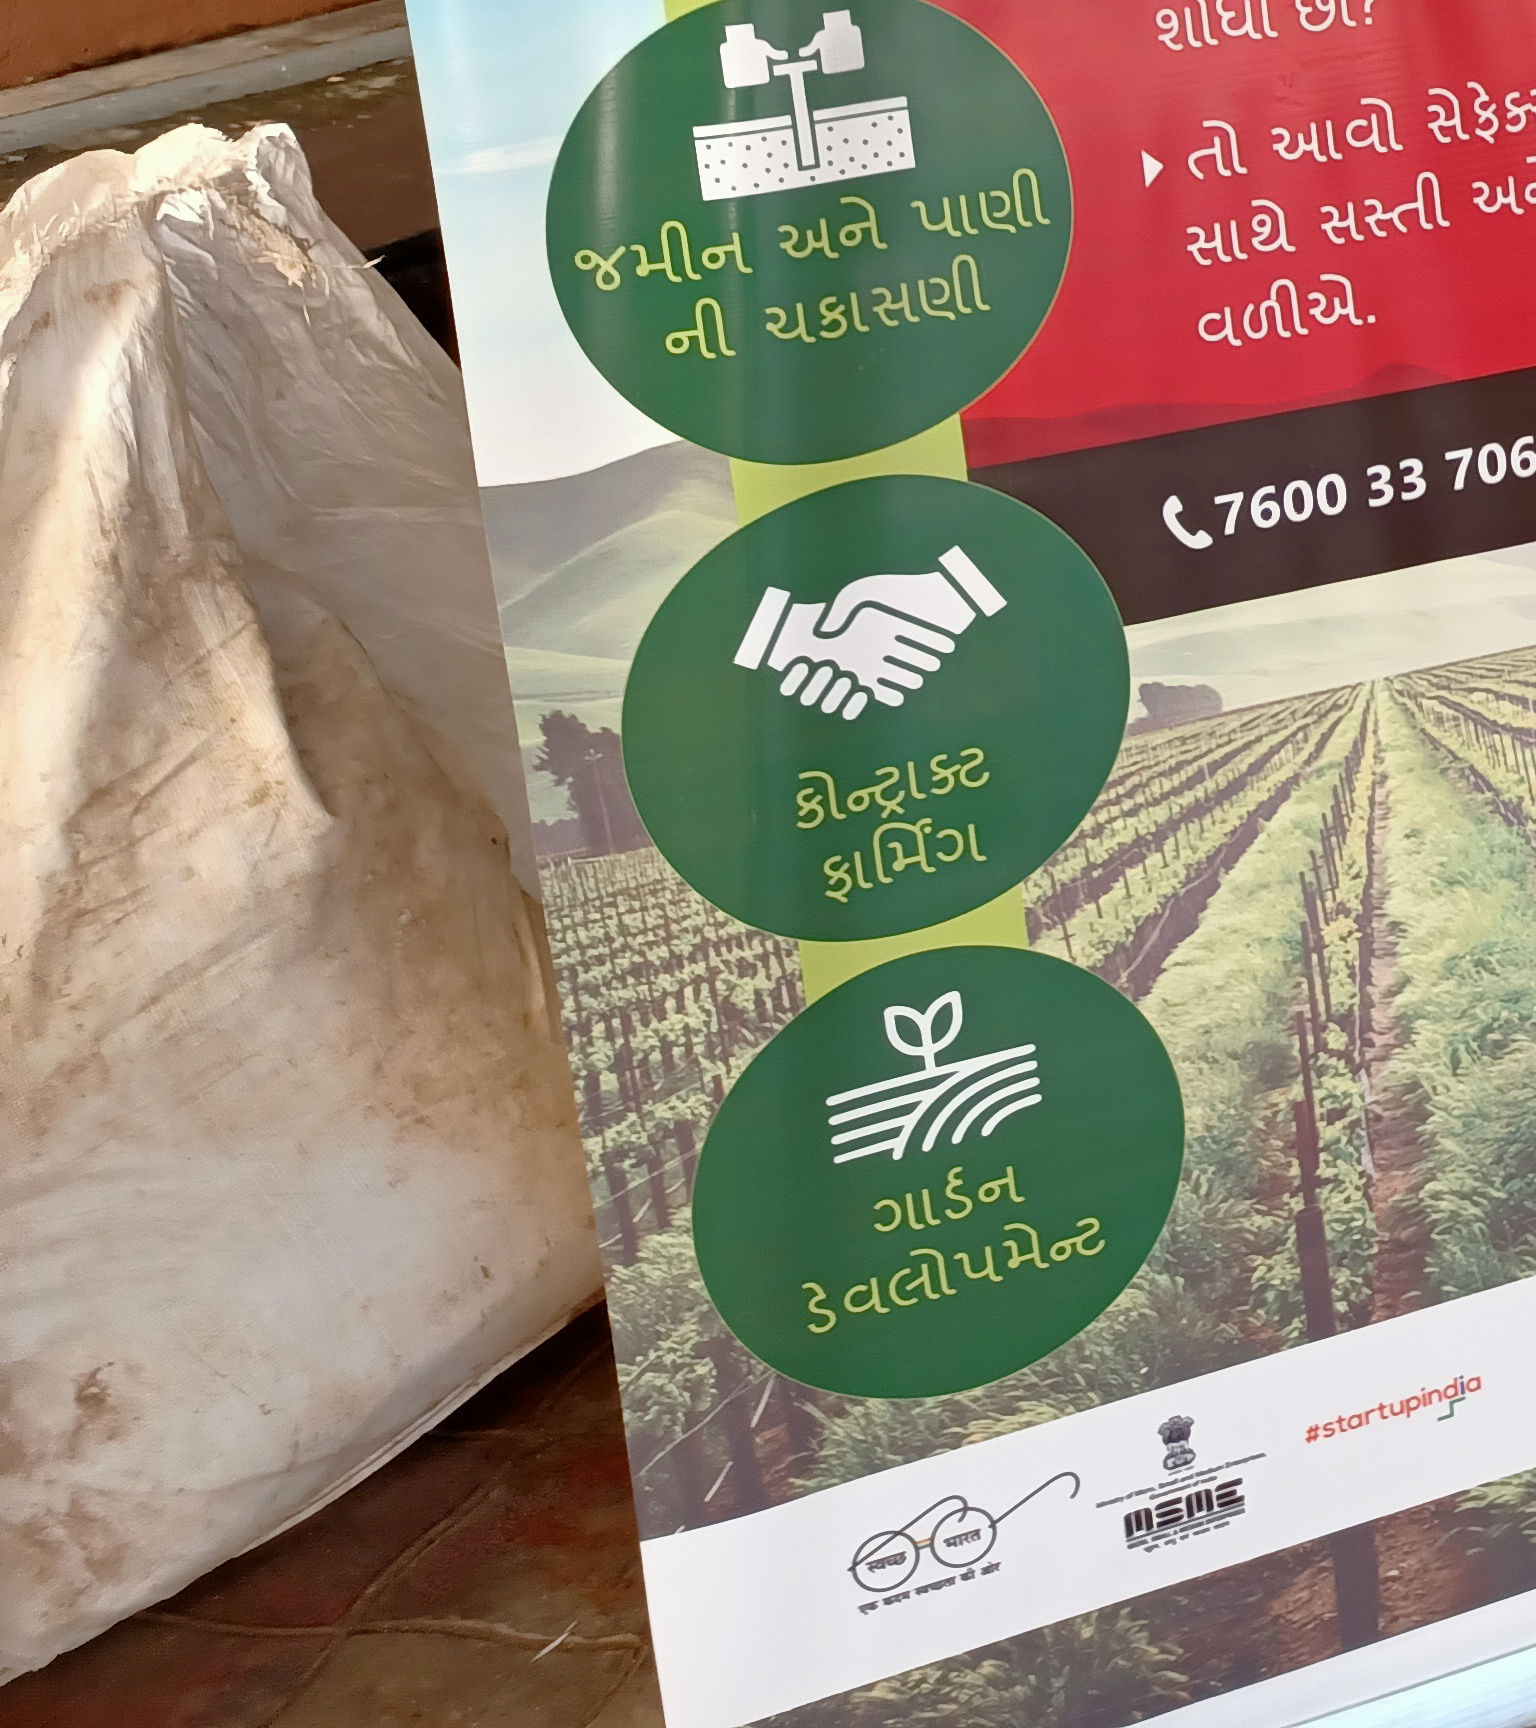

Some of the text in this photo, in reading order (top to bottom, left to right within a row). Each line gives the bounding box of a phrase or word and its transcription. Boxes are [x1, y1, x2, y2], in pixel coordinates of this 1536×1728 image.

[1185, 120, 1248, 184] તો
[1270, 96, 1405, 166] આવો
[574, 167, 1052, 292] જમીન અને પાણી
[1185, 198, 1296, 267] સાથે
[1320, 171, 1451, 248] સસ્તી
[665, 253, 991, 359] ની ચકાસણી
[1197, 273, 1378, 349] વળીએ.
[1213, 471, 1349, 537] 7600
[1366, 456, 1428, 508] 33
[1304, 1375, 1482, 1445] #startupindia
[943, 1528, 982, 1548] भारत
[1123, 1477, 1246, 1539] MSME
